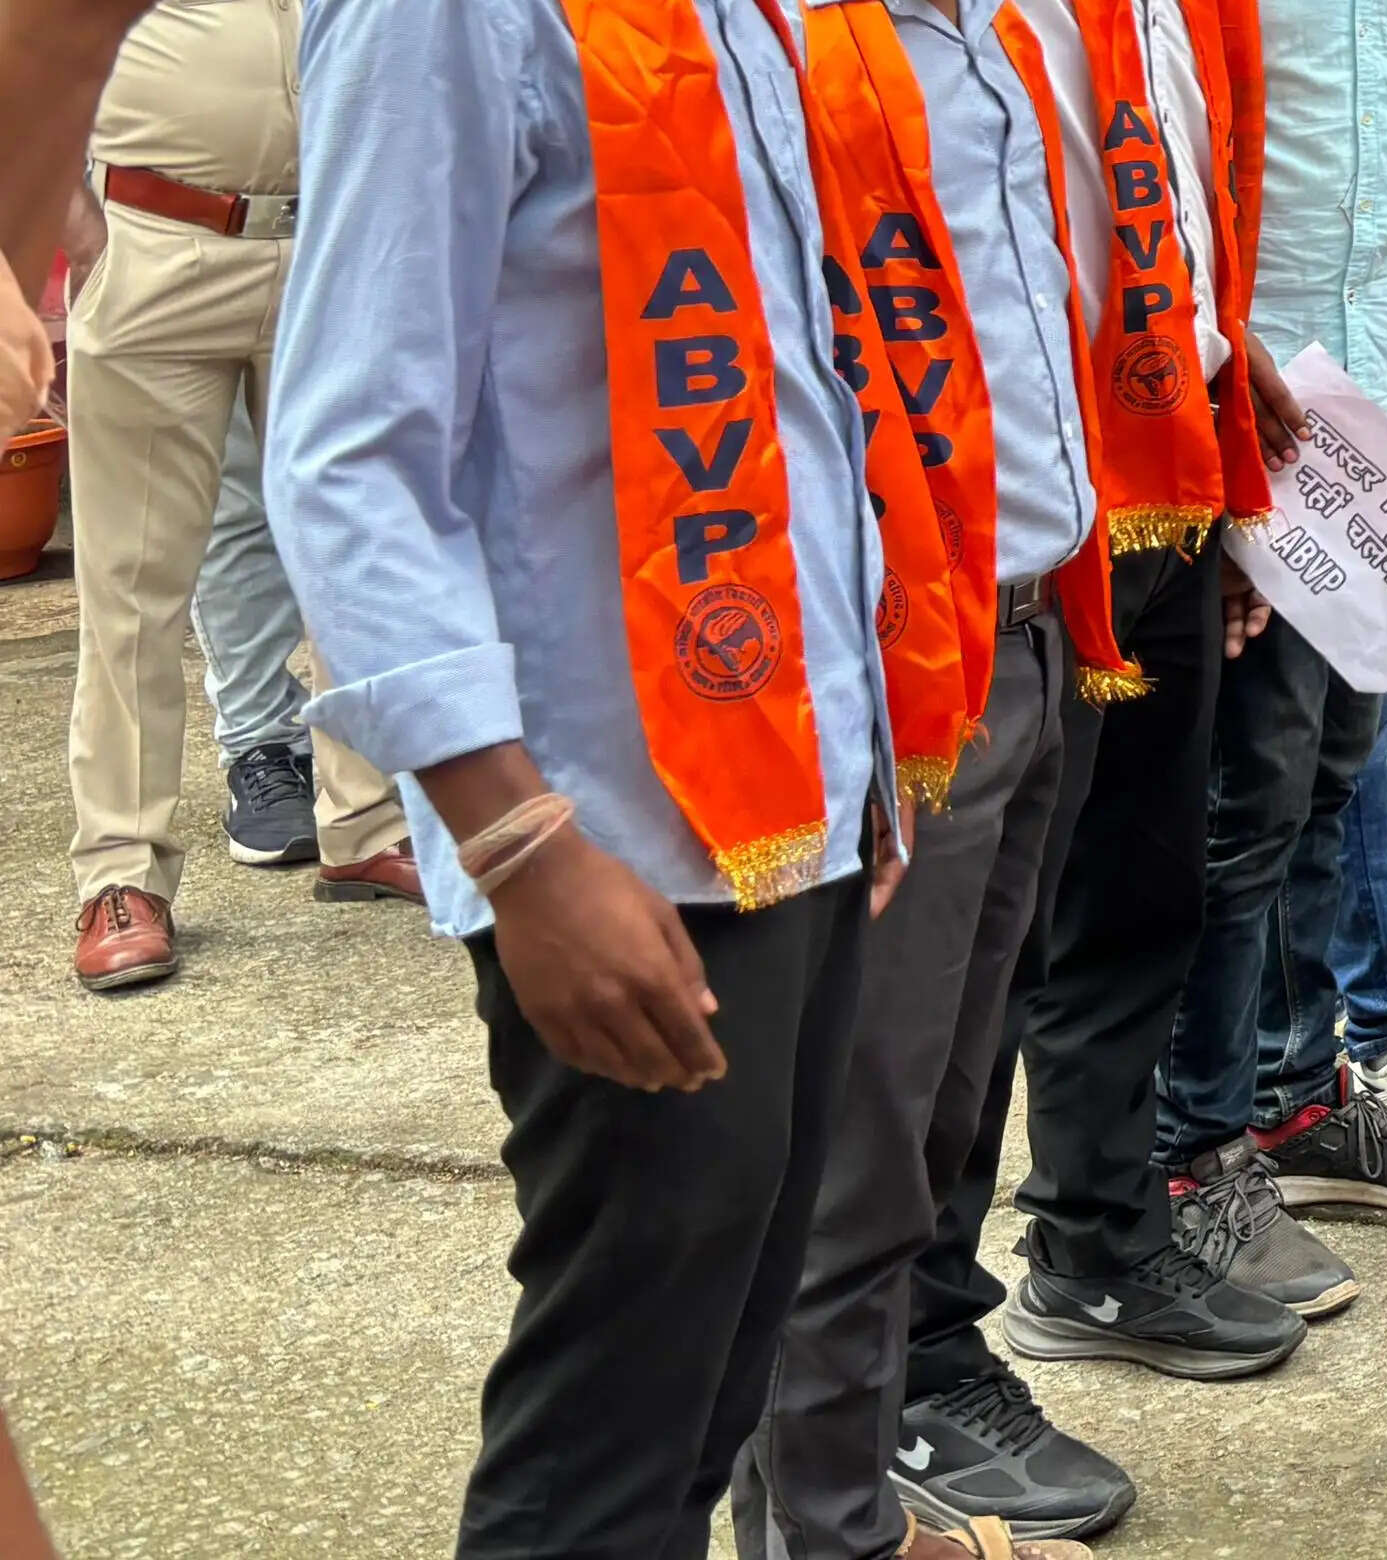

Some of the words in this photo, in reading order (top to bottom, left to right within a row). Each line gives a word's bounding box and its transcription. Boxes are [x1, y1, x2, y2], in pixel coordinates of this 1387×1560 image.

[1104, 100, 1174, 334] ABVP
[640, 248, 758, 585] ABVP
[1296, 465, 1354, 519] नहीं
[1270, 526, 1347, 595] ABVP
